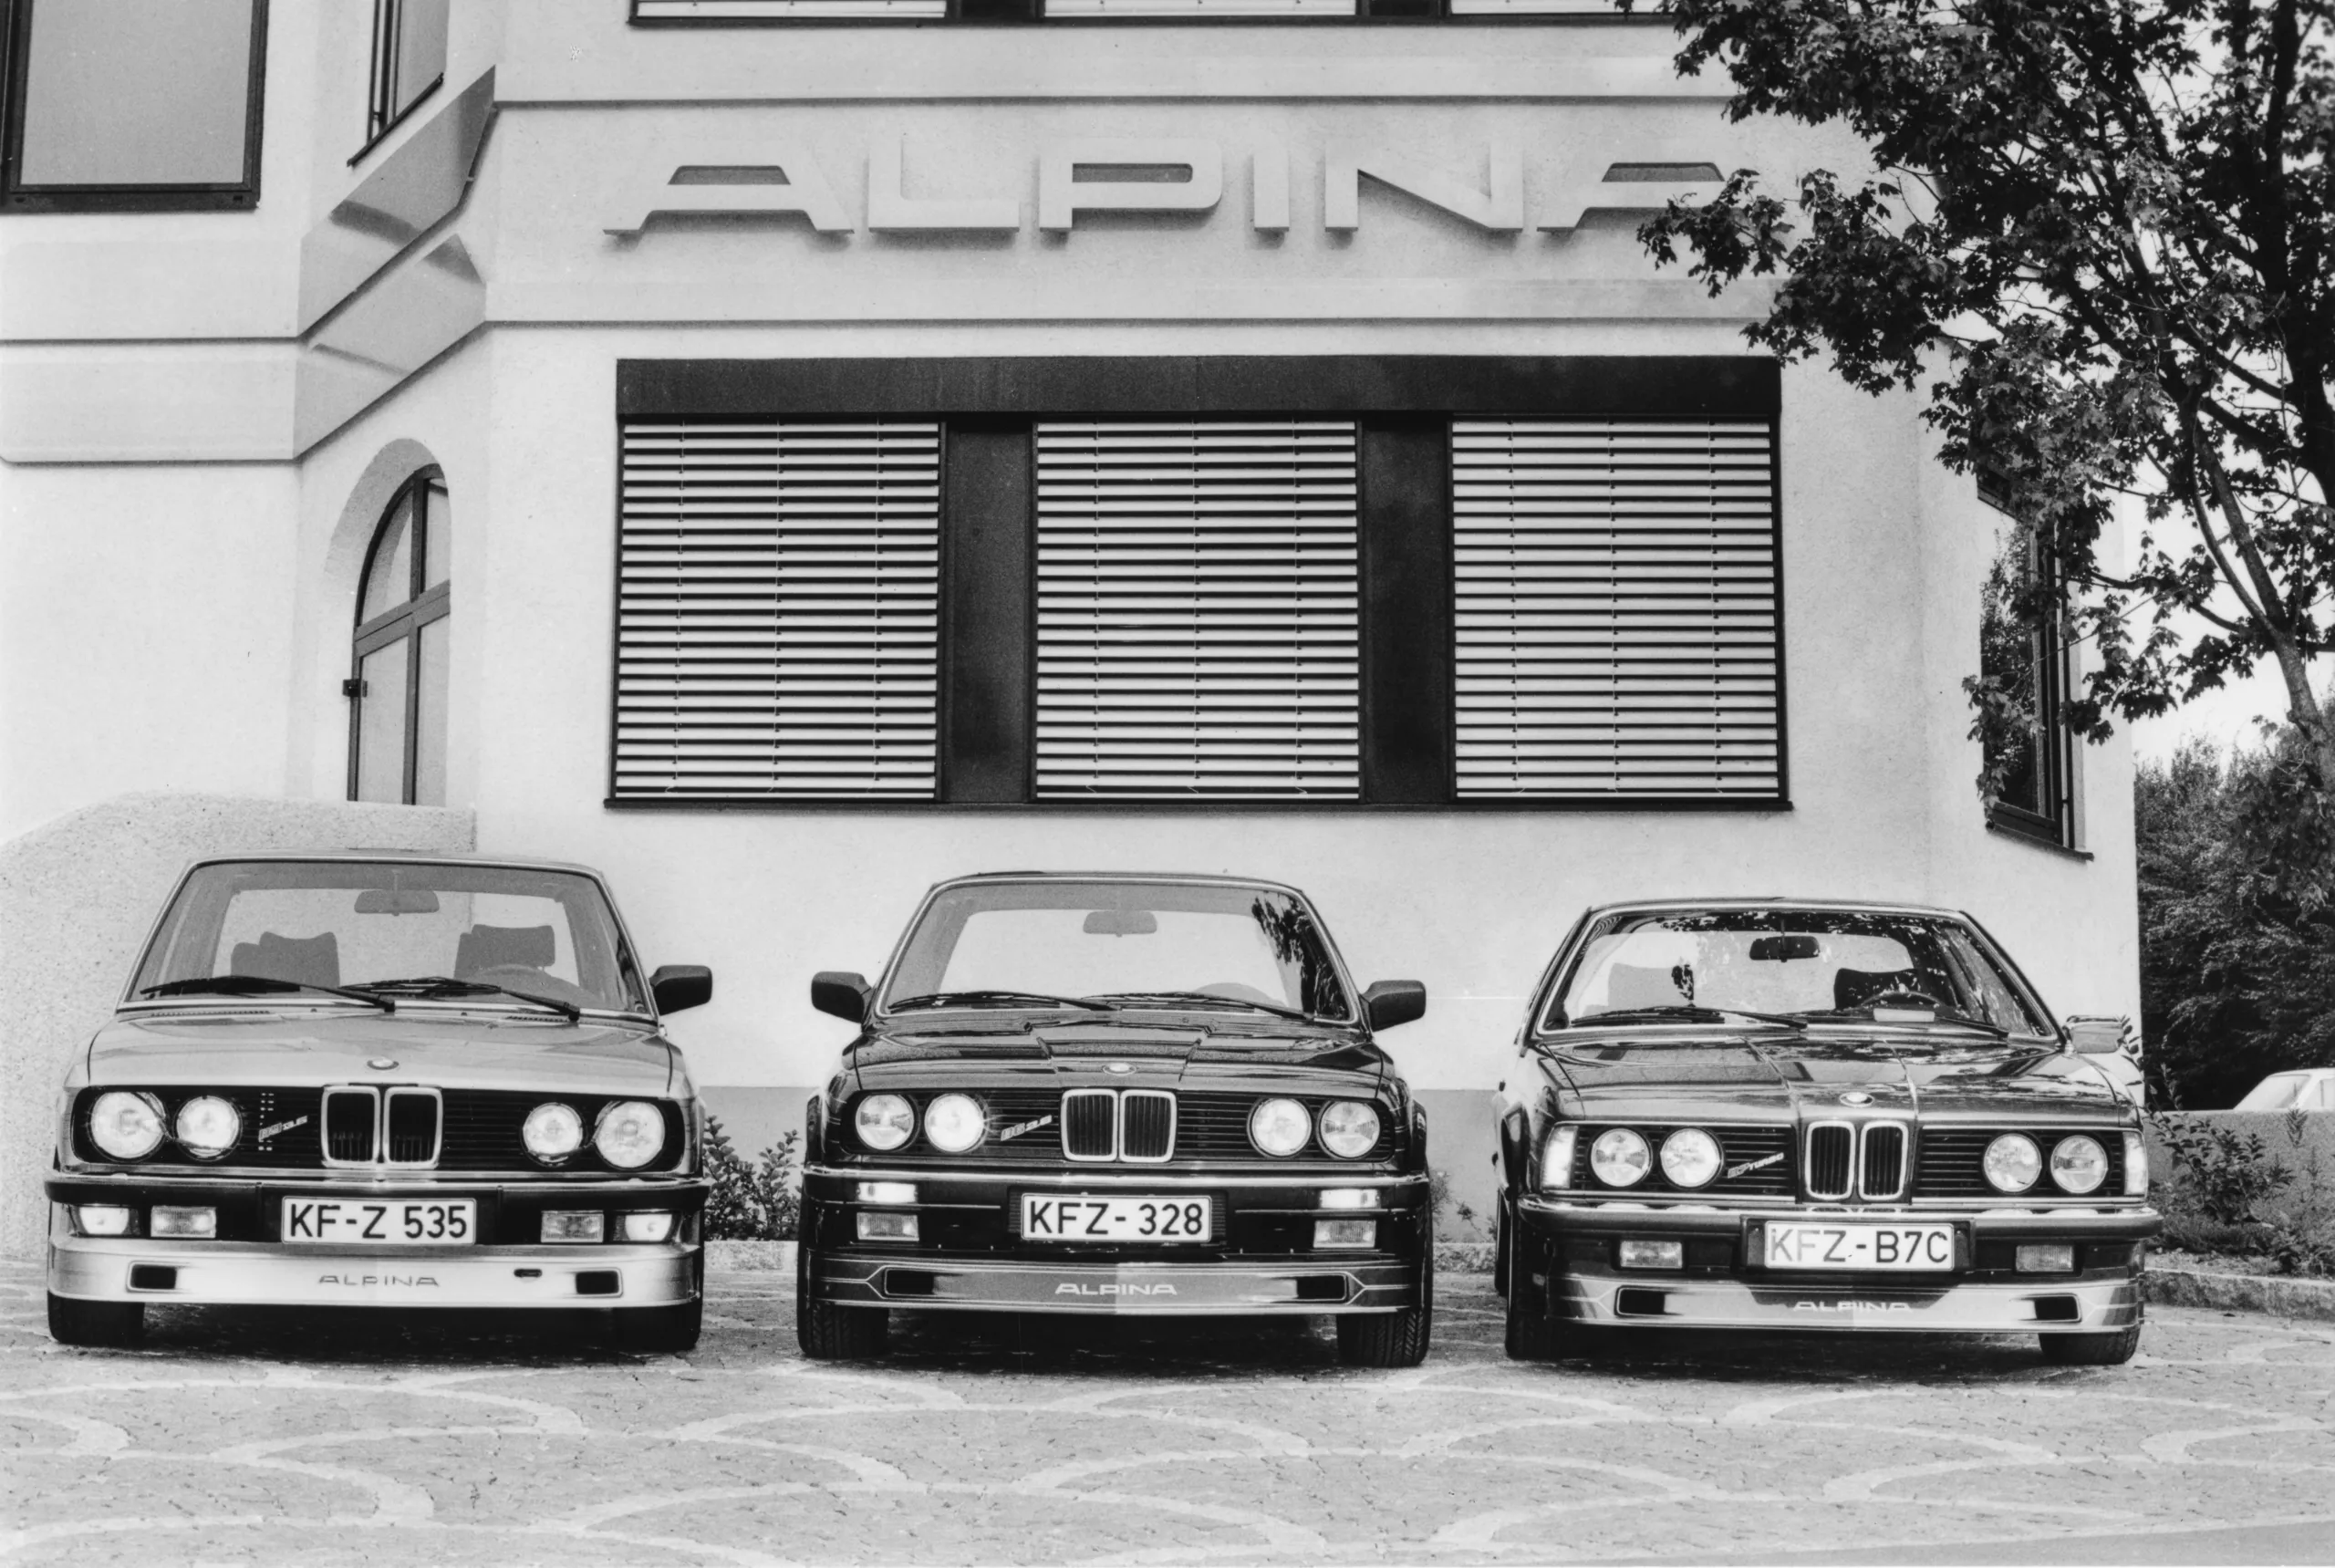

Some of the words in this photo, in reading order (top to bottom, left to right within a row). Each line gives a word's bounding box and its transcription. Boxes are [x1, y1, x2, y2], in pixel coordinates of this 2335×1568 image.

[600, 137, 1788, 233] ALPINA
[1749, 1151, 1784, 1170] TURBO
[290, 1203, 387, 1239] KF-Z
[404, 1205, 467, 1239] 535
[317, 1274, 440, 1287] ALPINA
[1054, 1282, 1178, 1295] ALPINA
[1793, 1301, 1914, 1313] ALPINA
